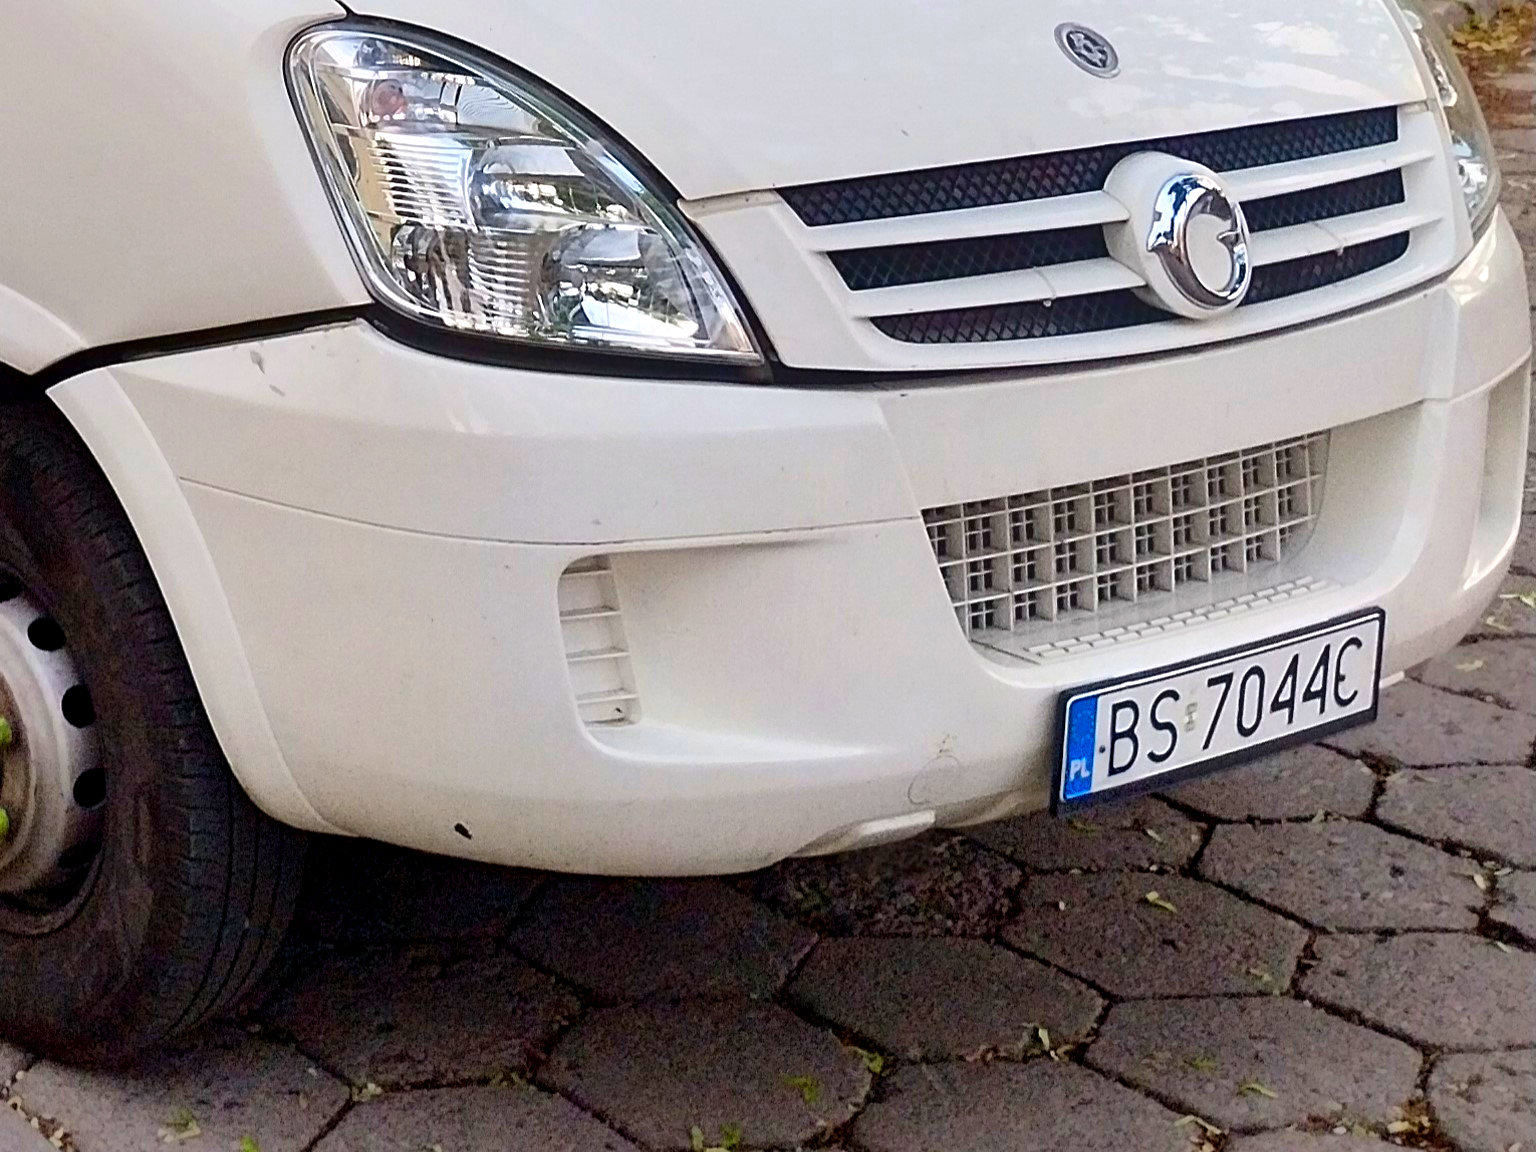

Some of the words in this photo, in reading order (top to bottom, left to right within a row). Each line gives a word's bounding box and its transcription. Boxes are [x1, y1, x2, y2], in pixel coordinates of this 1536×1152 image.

[1107, 689, 1180, 777] BS
[1202, 636, 1363, 751] 7044C
[1069, 757, 1090, 781] PL
